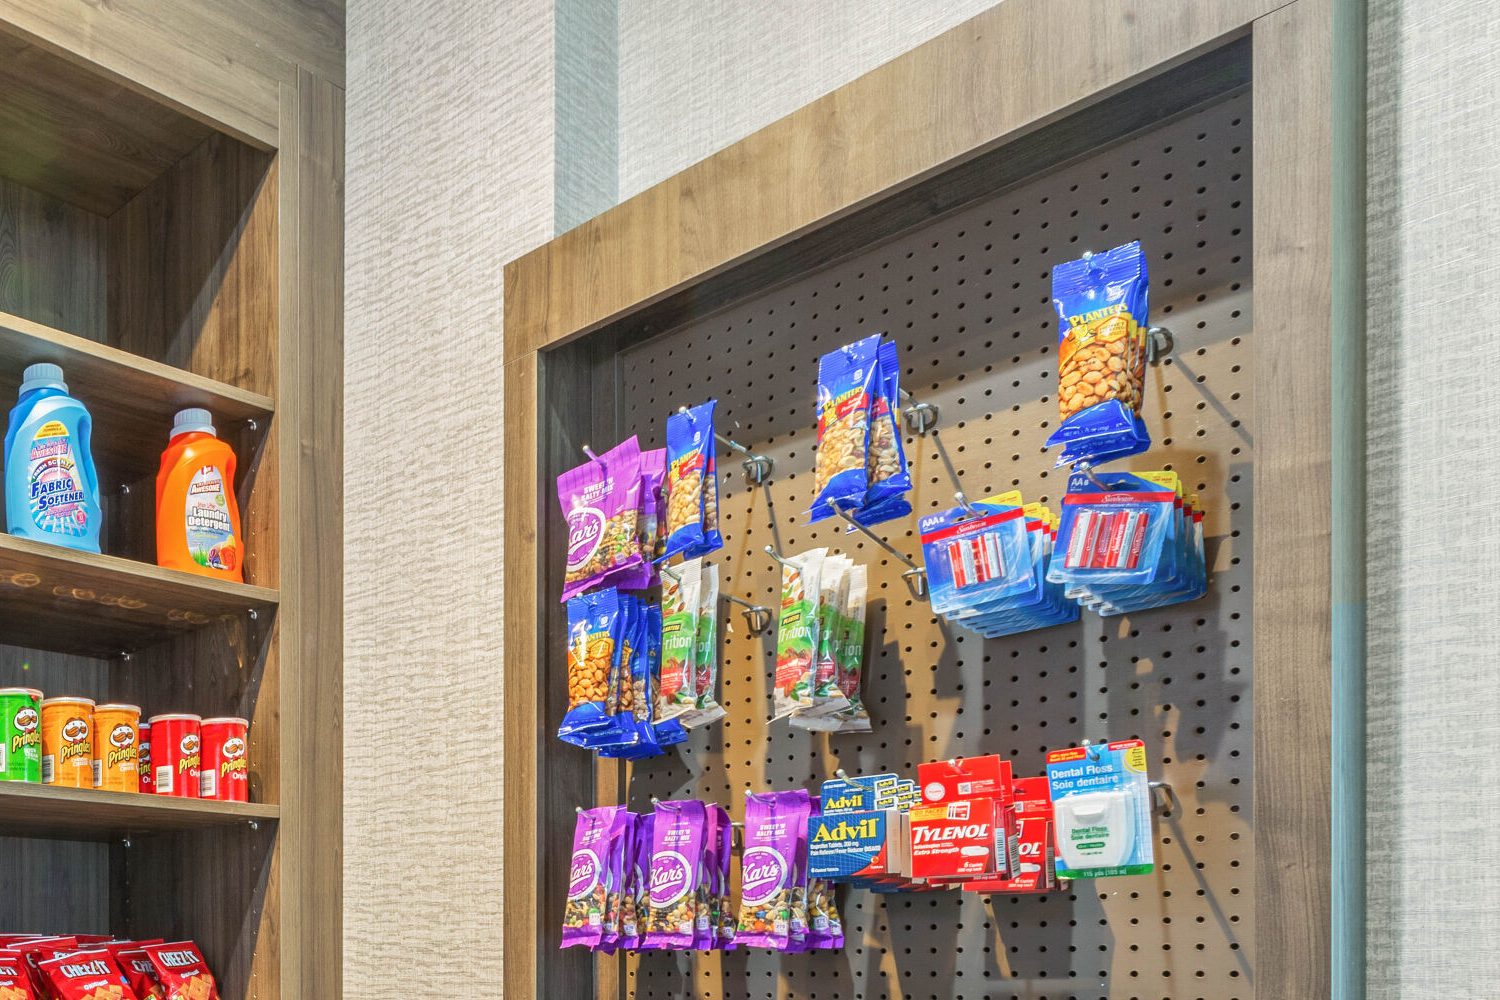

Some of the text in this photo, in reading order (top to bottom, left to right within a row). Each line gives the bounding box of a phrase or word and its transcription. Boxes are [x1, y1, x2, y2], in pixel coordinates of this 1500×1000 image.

[1069, 303, 1127, 326] PLANTERS
[31, 478, 72, 498] FABRIC
[191, 484, 220, 494] AWESOME
[1071, 478, 1083, 487] AA
[38, 492, 83, 510] SOFTENER
[1101, 494, 1135, 504] Sunbeam
[193, 506, 227, 522] Laundry
[188, 515, 230, 532] Detergent
[922, 518, 939, 528] AAA
[1051, 764, 1114, 780] Dental Floss
[1052, 774, 1119, 791] Soie dentaire
[825, 795, 864, 810] Advil
[812, 818, 877, 843] Advil
[913, 824, 989, 845] TYLENOL
[1071, 826, 1090, 834] Dental
[1085, 832, 1109, 840] dentaire
[914, 847, 959, 856] Extra Strength
